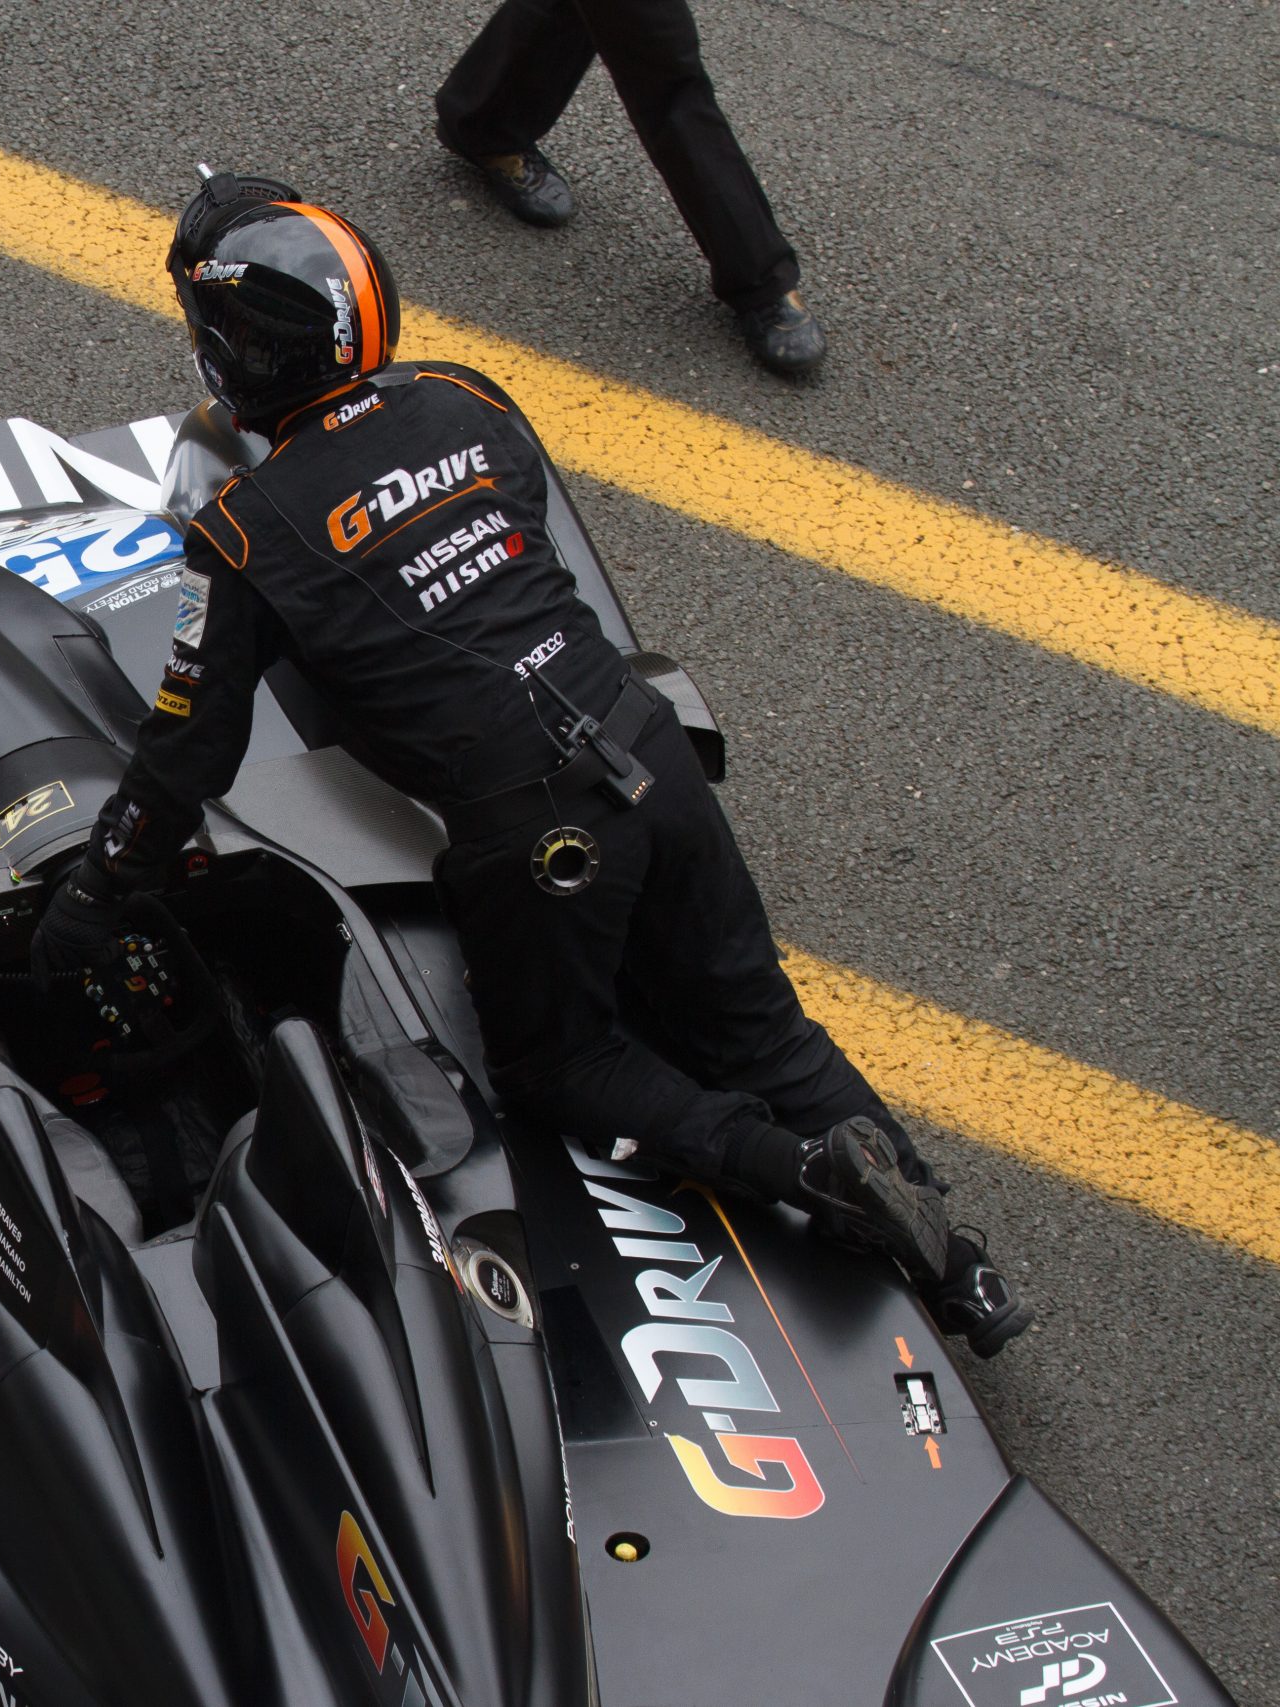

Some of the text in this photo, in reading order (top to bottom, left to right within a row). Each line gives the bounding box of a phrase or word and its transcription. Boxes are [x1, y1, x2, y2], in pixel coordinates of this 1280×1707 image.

[192, 259, 249, 281] G-DRIVE
[325, 277, 354, 365] G-DRIVE
[323, 393, 380, 431] G-DRIVE
[327, 444, 490, 553] G-DRIVE
[398, 510, 511, 587] NISSAN
[86, 590, 128, 614] SAFETY
[108, 584, 159, 611] ACTION
[128, 577, 159, 593] ROAD
[514, 630, 564, 678] sparco
[971, 1628, 1109, 1673] ACADEMY
[994, 1622, 1065, 1646] PS3
